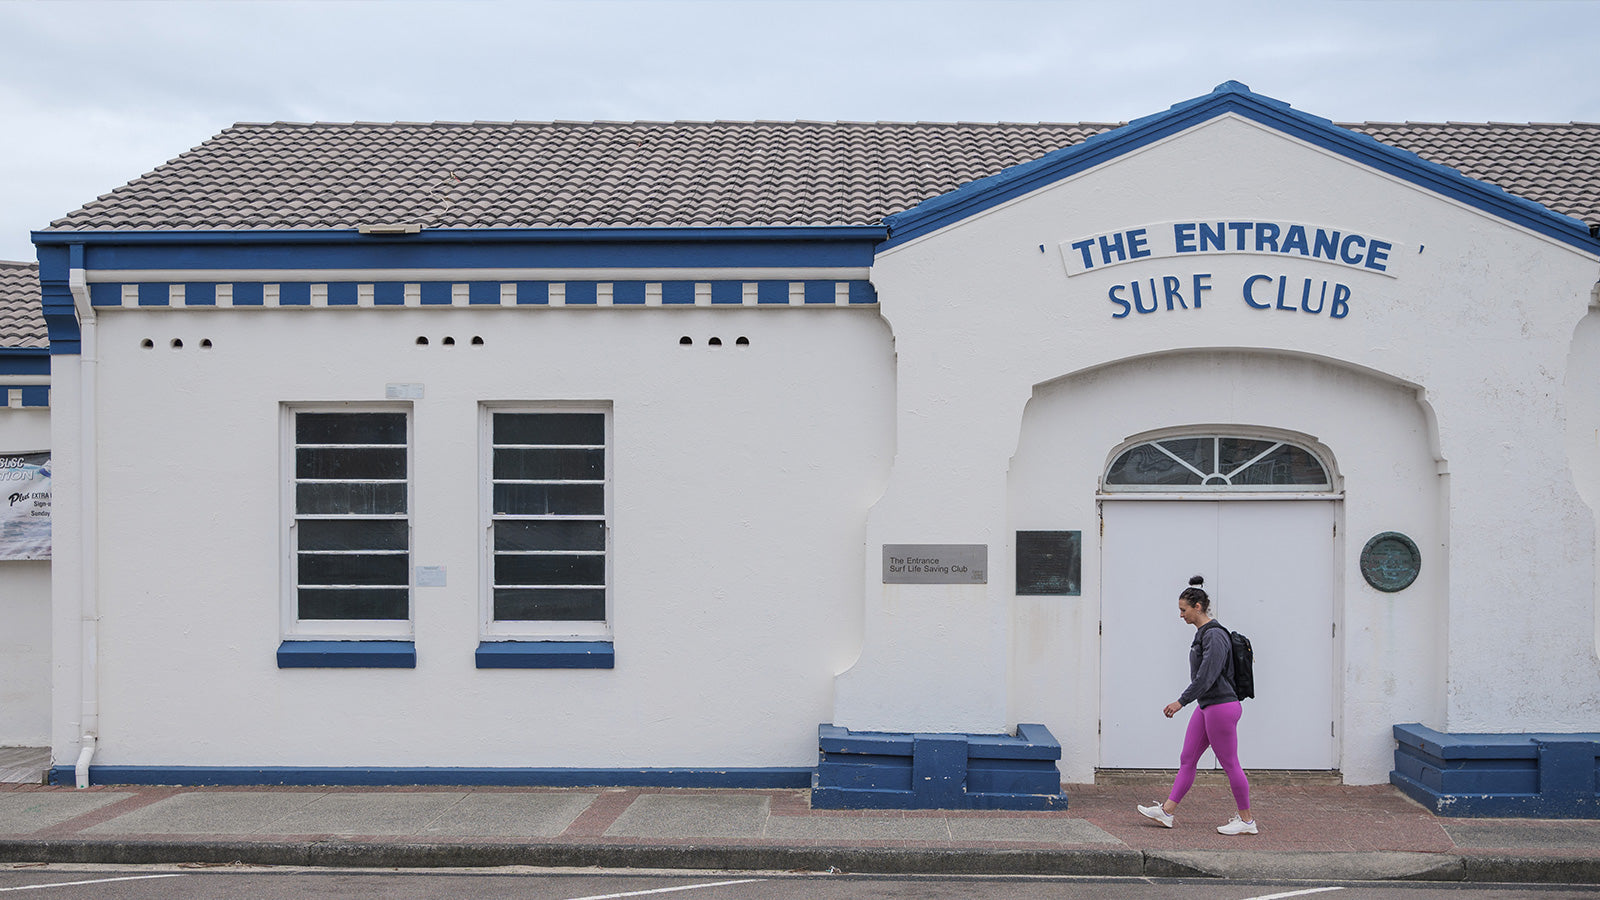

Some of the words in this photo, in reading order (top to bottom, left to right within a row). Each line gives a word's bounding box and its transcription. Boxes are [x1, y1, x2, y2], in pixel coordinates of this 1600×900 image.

[1072, 229, 1151, 269] THE
[1174, 222, 1393, 271] ENTRANCE
[1108, 273, 1212, 319] SURF
[1243, 274, 1352, 319] CLUB
[924, 565, 948, 574] Saving
